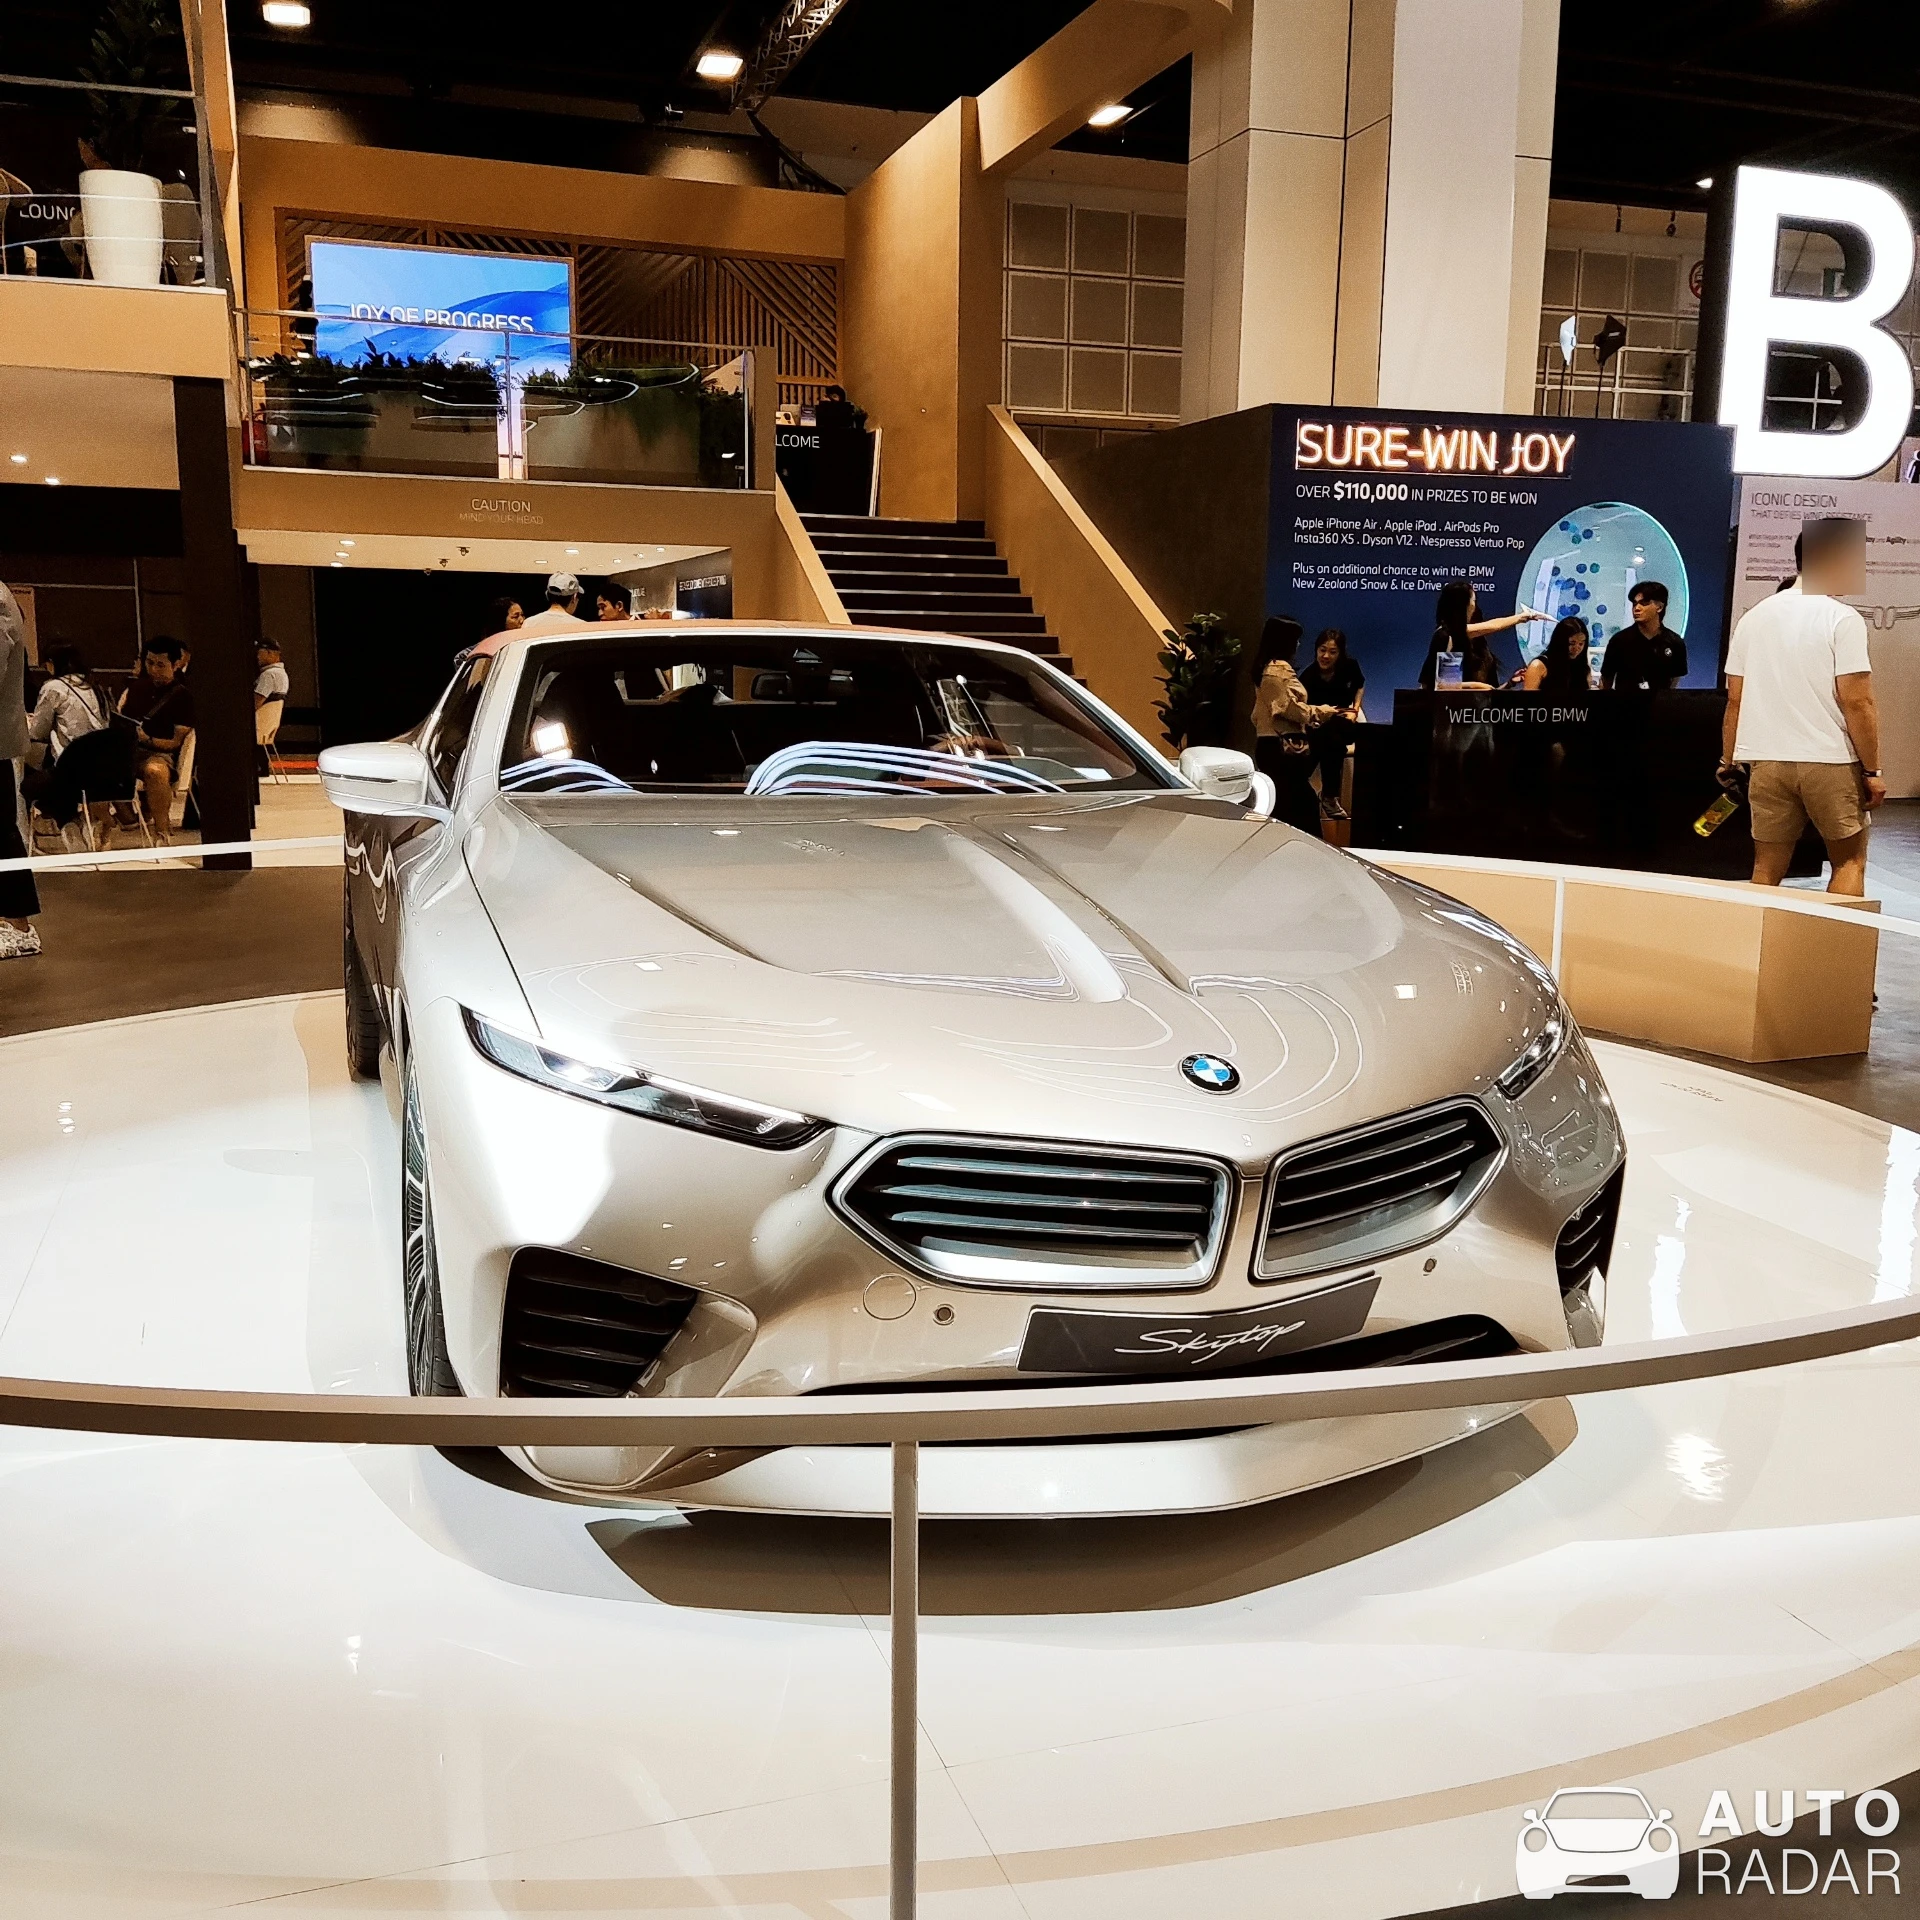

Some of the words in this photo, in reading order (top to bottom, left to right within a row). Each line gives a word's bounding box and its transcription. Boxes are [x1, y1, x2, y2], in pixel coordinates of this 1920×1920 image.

[19, 203, 76, 220] LOUN
[1718, 165, 1915, 480] B
[775, 434, 820, 449] LCOME
[1297, 423, 1498, 471] SURE-WIN
[1502, 430, 1576, 474] JOY
[1296, 484, 1331, 498] OVER
[1333, 480, 1408, 503] $110,000
[1411, 488, 1424, 501] IN
[1426, 489, 1469, 503] PRIZES
[1471, 490, 1488, 504] TO
[1490, 491, 1507, 504] BE
[1509, 491, 1538, 505] WON
[1751, 492, 1791, 506] ICONIC
[1793, 493, 1838, 508] DESIGN
[471, 498, 531, 513] CAUTION
[459, 512, 484, 523] MIND
[487, 513, 514, 524] YOUR
[516, 514, 544, 525] HEAD
[1294, 516, 1325, 531] Apple
[1326, 517, 1361, 530] iPhone
[1362, 518, 1378, 530] Air
[1384, 519, 1413, 532] Apple
[1444, 521, 1481, 533] AirPods
[1483, 521, 1500, 533] Pro
[1294, 532, 1339, 544] Insta360
[1340, 533, 1355, 545] X5
[1362, 533, 1394, 547] Dyson
[1396, 534, 1413, 546] V12
[1420, 535, 1471, 548] Nespresso
[1473, 536, 1504, 548] Vertuo
[1506, 537, 1525, 551] Pop
[1293, 562, 1315, 574] Plus
[1332, 563, 1381, 575] additional
[1382, 564, 1418, 576] chance
[1420, 565, 1430, 576] to
[1431, 565, 1449, 576] win
[1450, 565, 1466, 577] the
[1468, 565, 1495, 577] BMW
[1292, 577, 1316, 589] New
[1317, 577, 1359, 590] Zealand
[1360, 578, 1389, 590] Snow
[1390, 578, 1399, 590] &
[1401, 579, 1415, 590] Ice
[1417, 579, 1442, 591] Drive
[1449, 708, 1524, 724] WELCOME
[1527, 708, 1548, 723] TO
[1551, 707, 1589, 723] BMW
[1113, 1320, 1306, 1365] Skytop
